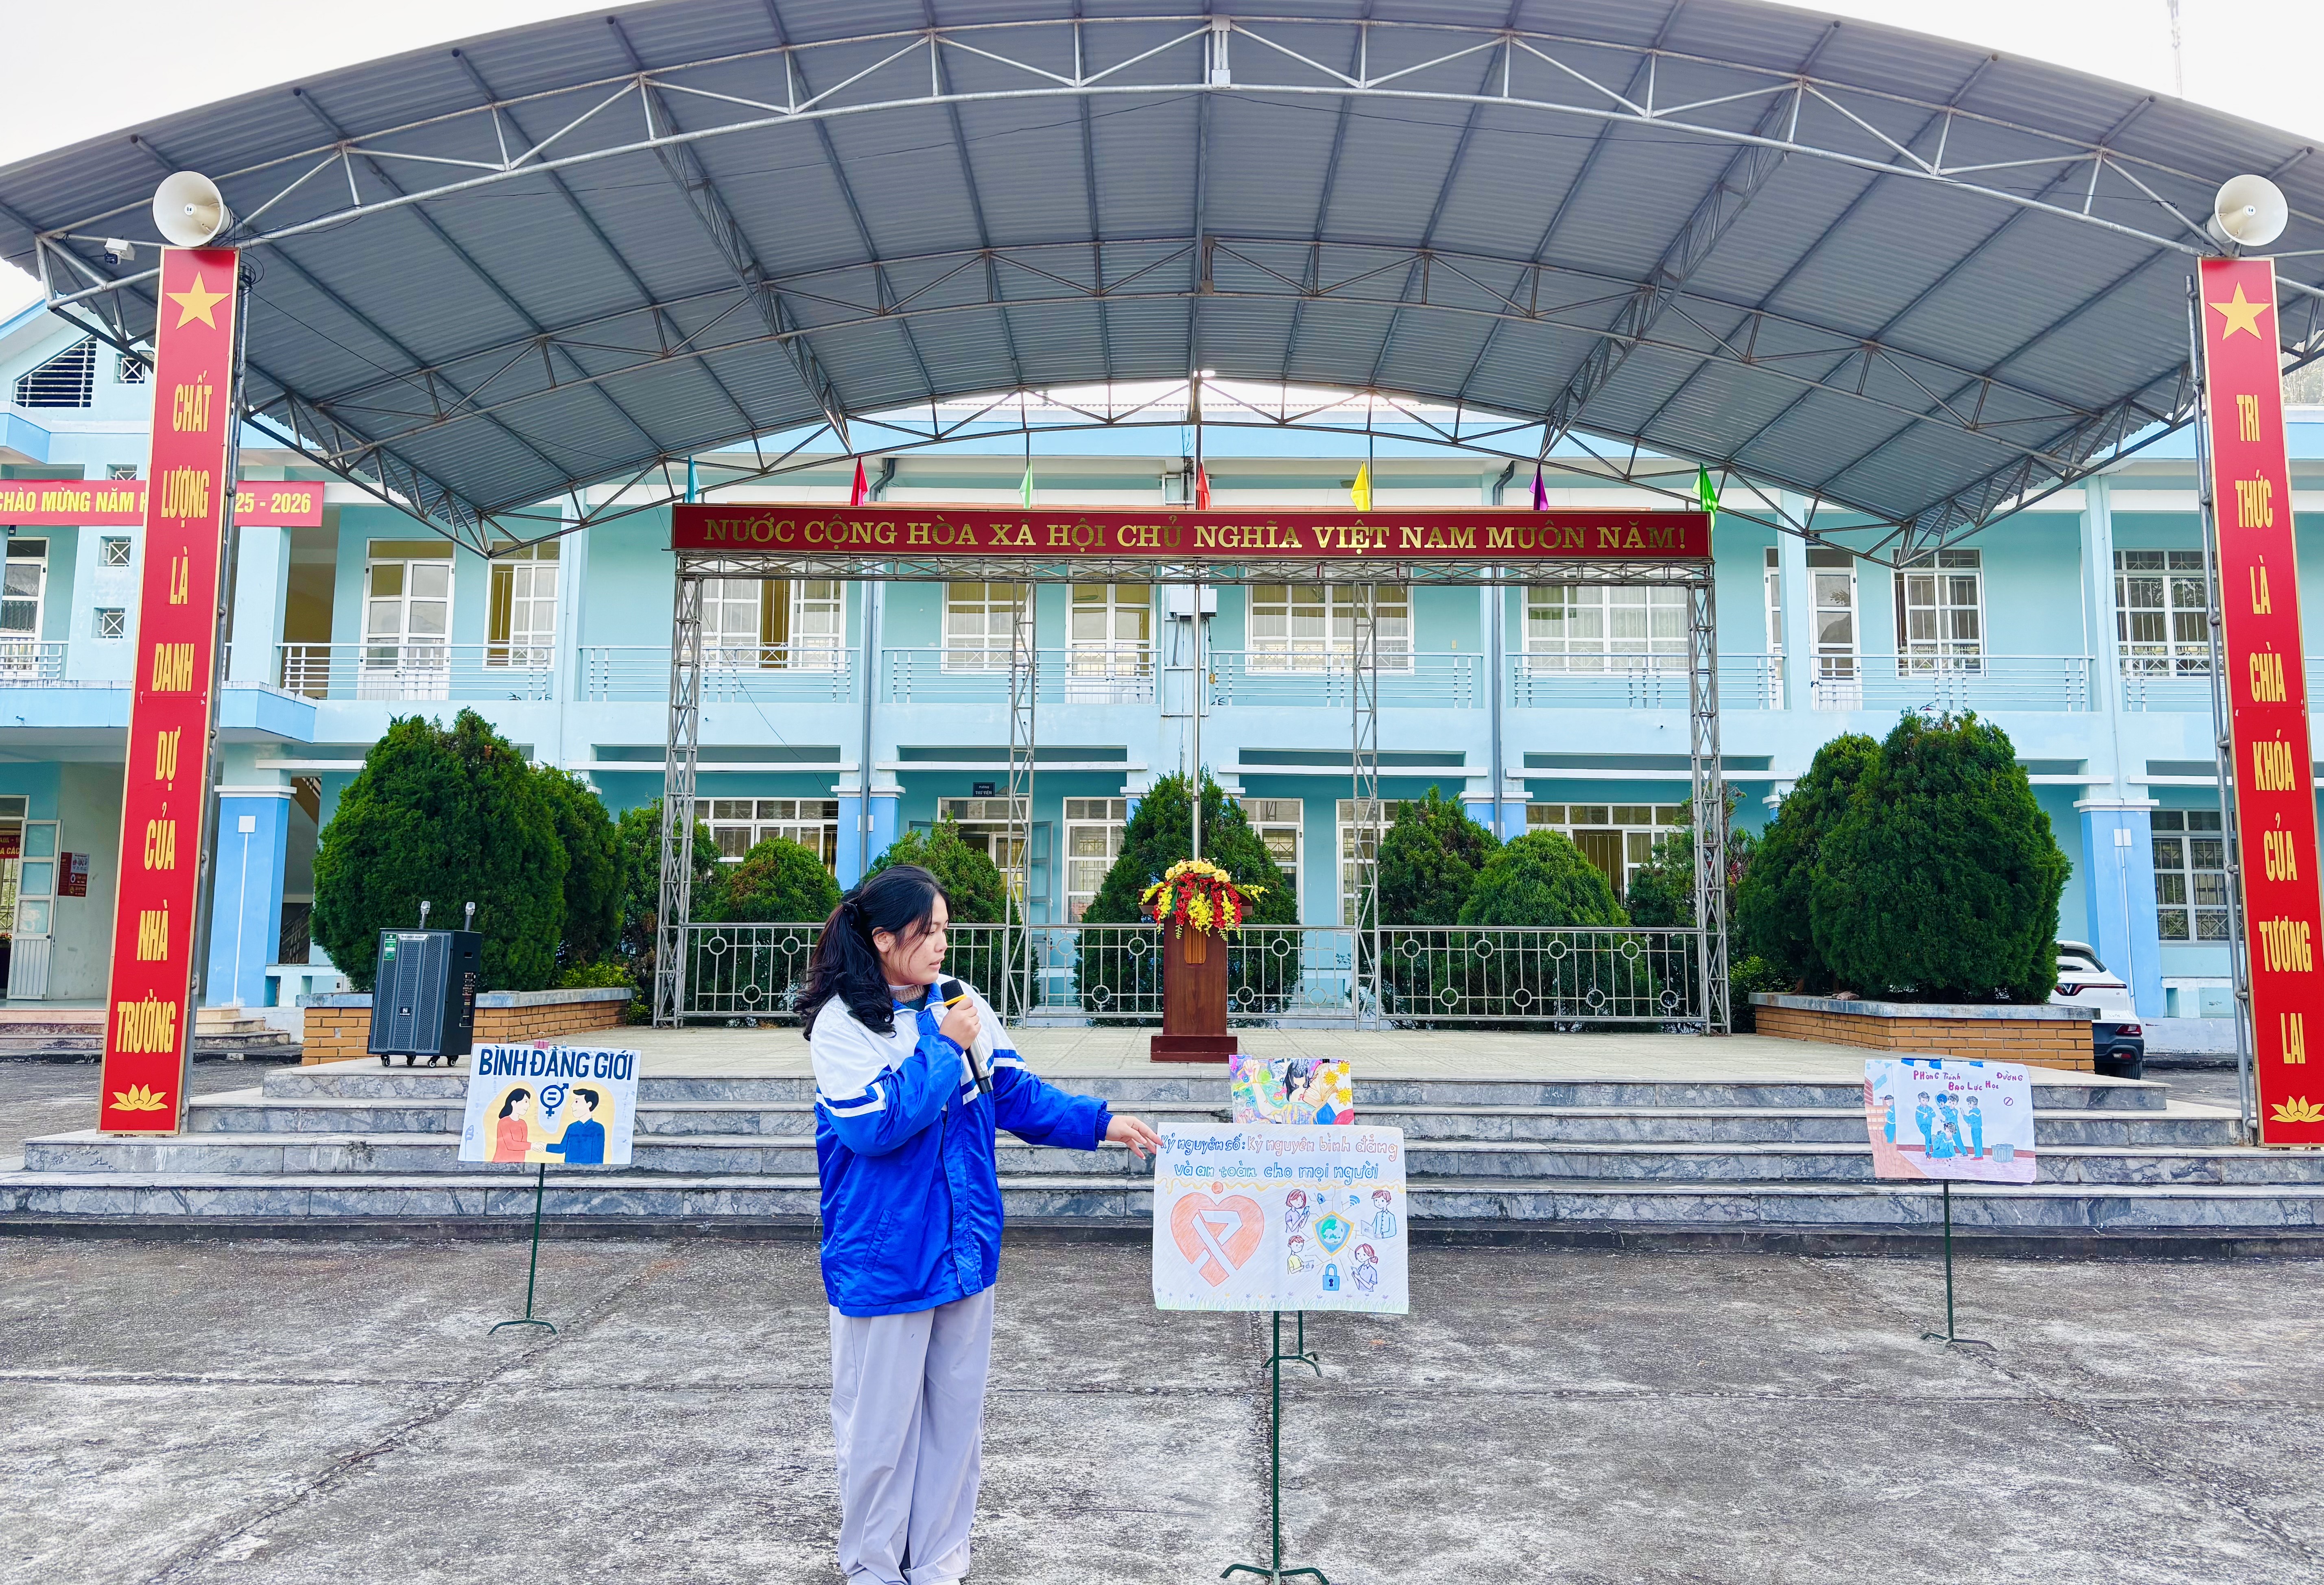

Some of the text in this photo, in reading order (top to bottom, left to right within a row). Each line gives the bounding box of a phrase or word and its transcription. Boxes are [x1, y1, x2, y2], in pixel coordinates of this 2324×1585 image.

[41, 487, 91, 512] MỪNG
[95, 487, 135, 512] NĂM
[270, 493, 311, 513] 2026
[703, 512, 1686, 555] NƯỚC CỘNG HÒA XÃ HỘI CHỦ NGHĨA VIỆT NAM MUÔN NĂM!
[116, 370, 213, 1054] CHẤT LƯỢNG LÀ DANH DỰ CỦA NHÀ TRƯỜNG
[2234, 394, 2313, 1064] TRI THỨC LÀ CHÌA KHÓA CỦA TƯƠNG LAI
[479, 1045, 633, 1081] BÌNH ĐẲNG GIỚI
[1967, 1082, 1983, 1092] Lực
[1985, 1081, 1999, 1090] Học
[1161, 1133, 1176, 1154] Kỷ
[1177, 1136, 1224, 1155] nguyên
[1247, 1134, 1264, 1153] Kỷ
[1266, 1136, 1315, 1156] nguyên
[1319, 1133, 1351, 1152] bình
[1356, 1134, 1398, 1162] đẳng
[1174, 1160, 1379, 1186] và an toàn cho mọi người
